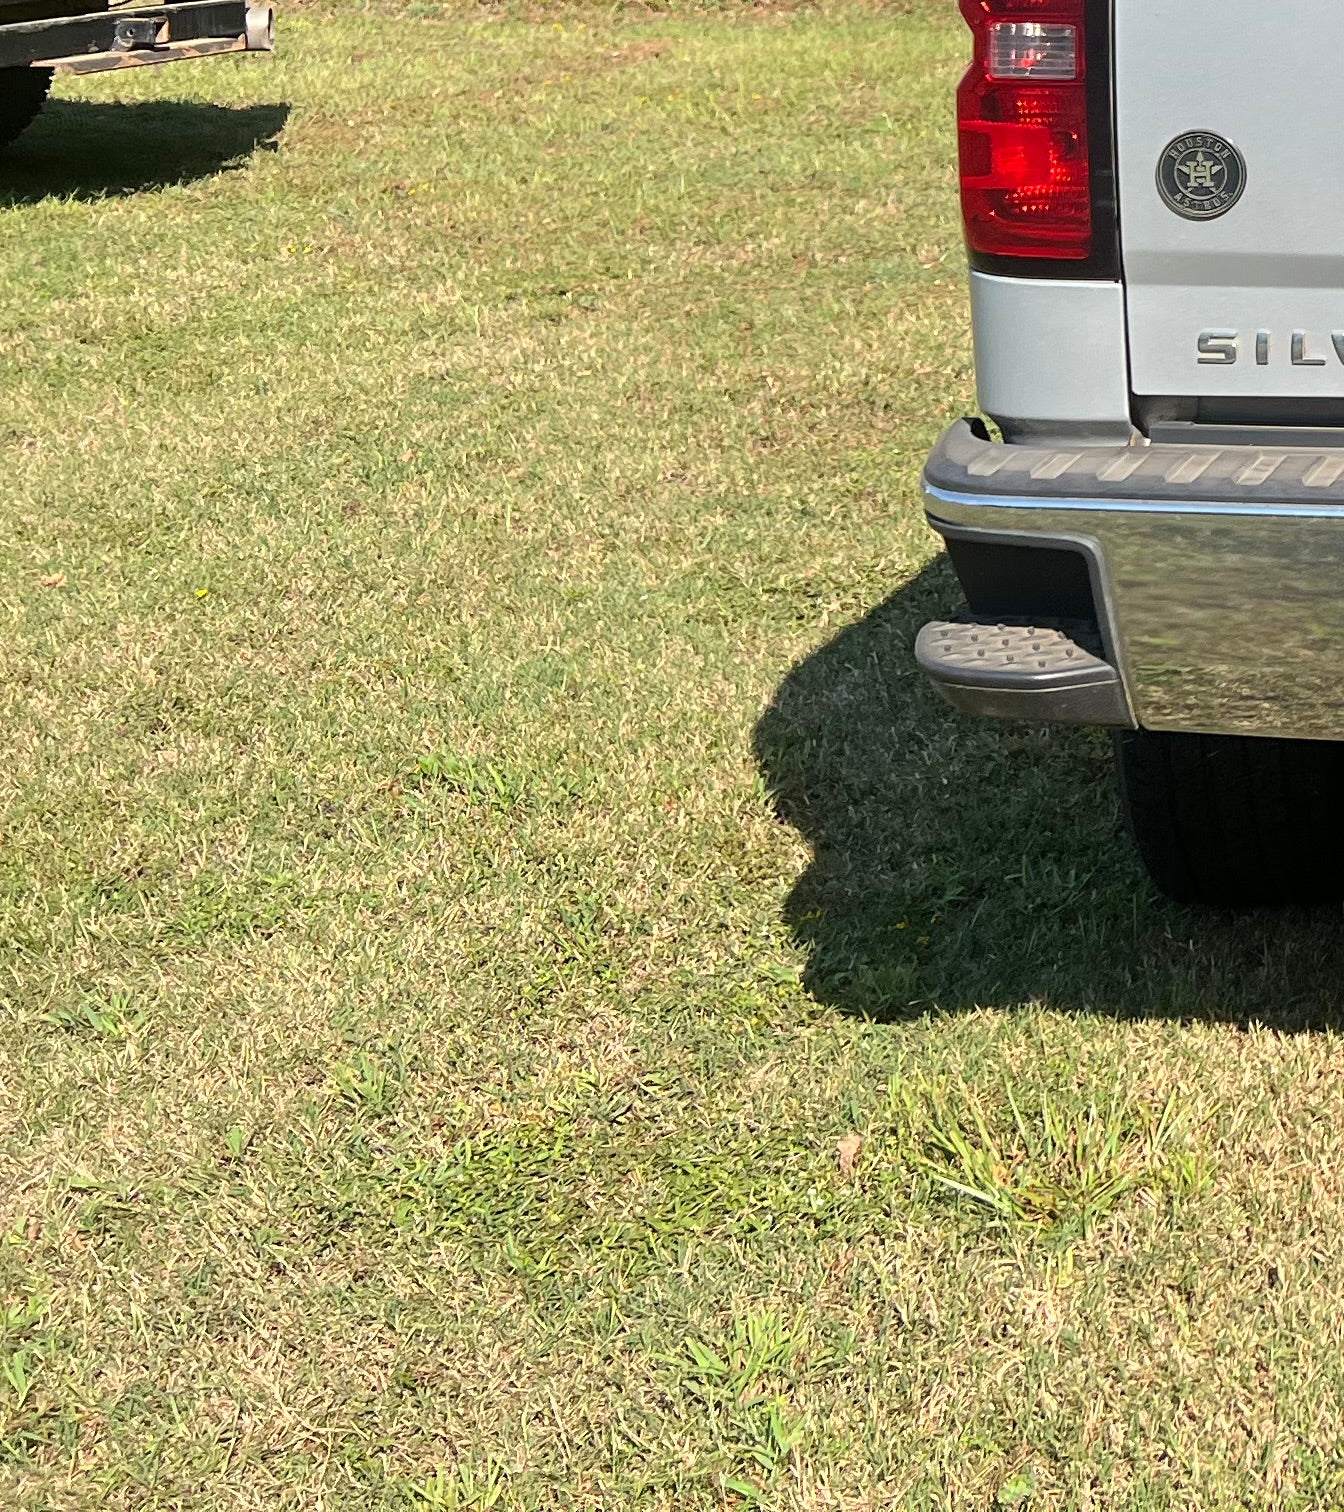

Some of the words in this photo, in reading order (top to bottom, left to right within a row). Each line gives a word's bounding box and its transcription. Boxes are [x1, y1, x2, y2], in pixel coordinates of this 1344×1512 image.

[1168, 136, 1232, 160] HOUSTON
[1186, 160, 1215, 187] H
[1173, 192, 1230, 210] ASTROS
